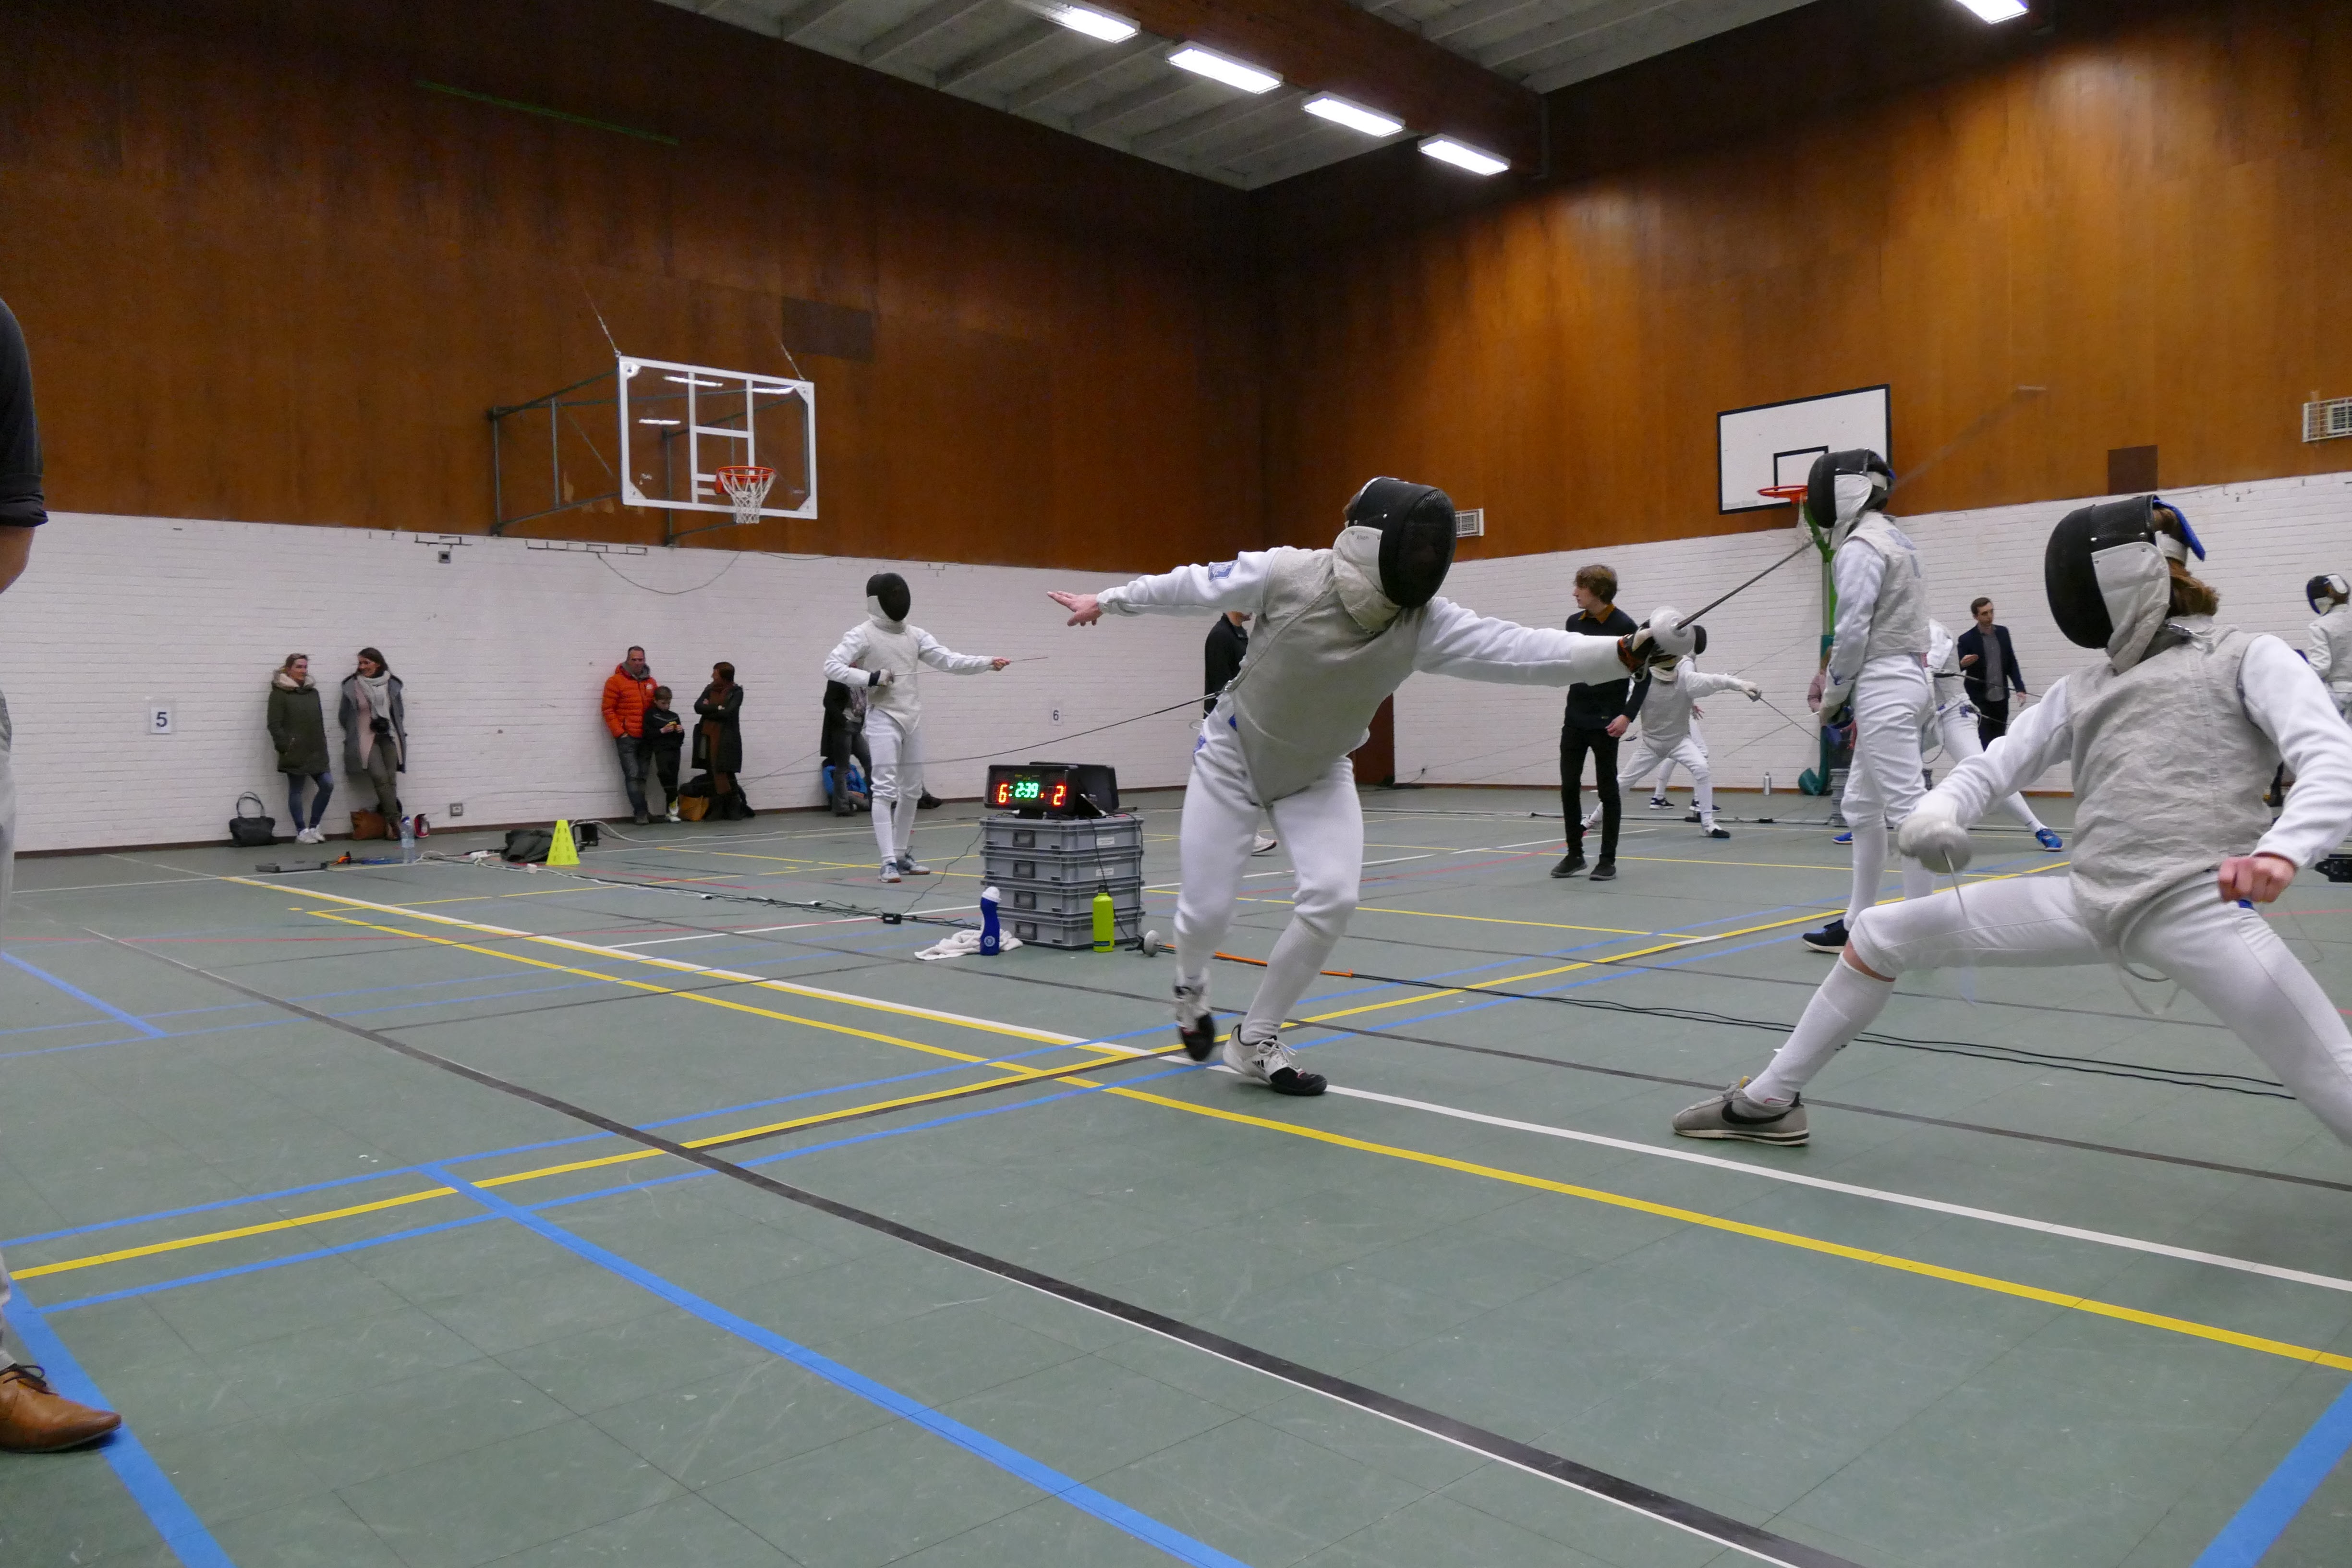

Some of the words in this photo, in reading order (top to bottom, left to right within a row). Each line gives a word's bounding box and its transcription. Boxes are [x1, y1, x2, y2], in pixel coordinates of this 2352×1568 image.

[156, 712, 168, 727] 5
[1053, 710, 1059, 721] 6
[998, 784, 1008, 803] 6
[1053, 785, 1064, 805] 2
